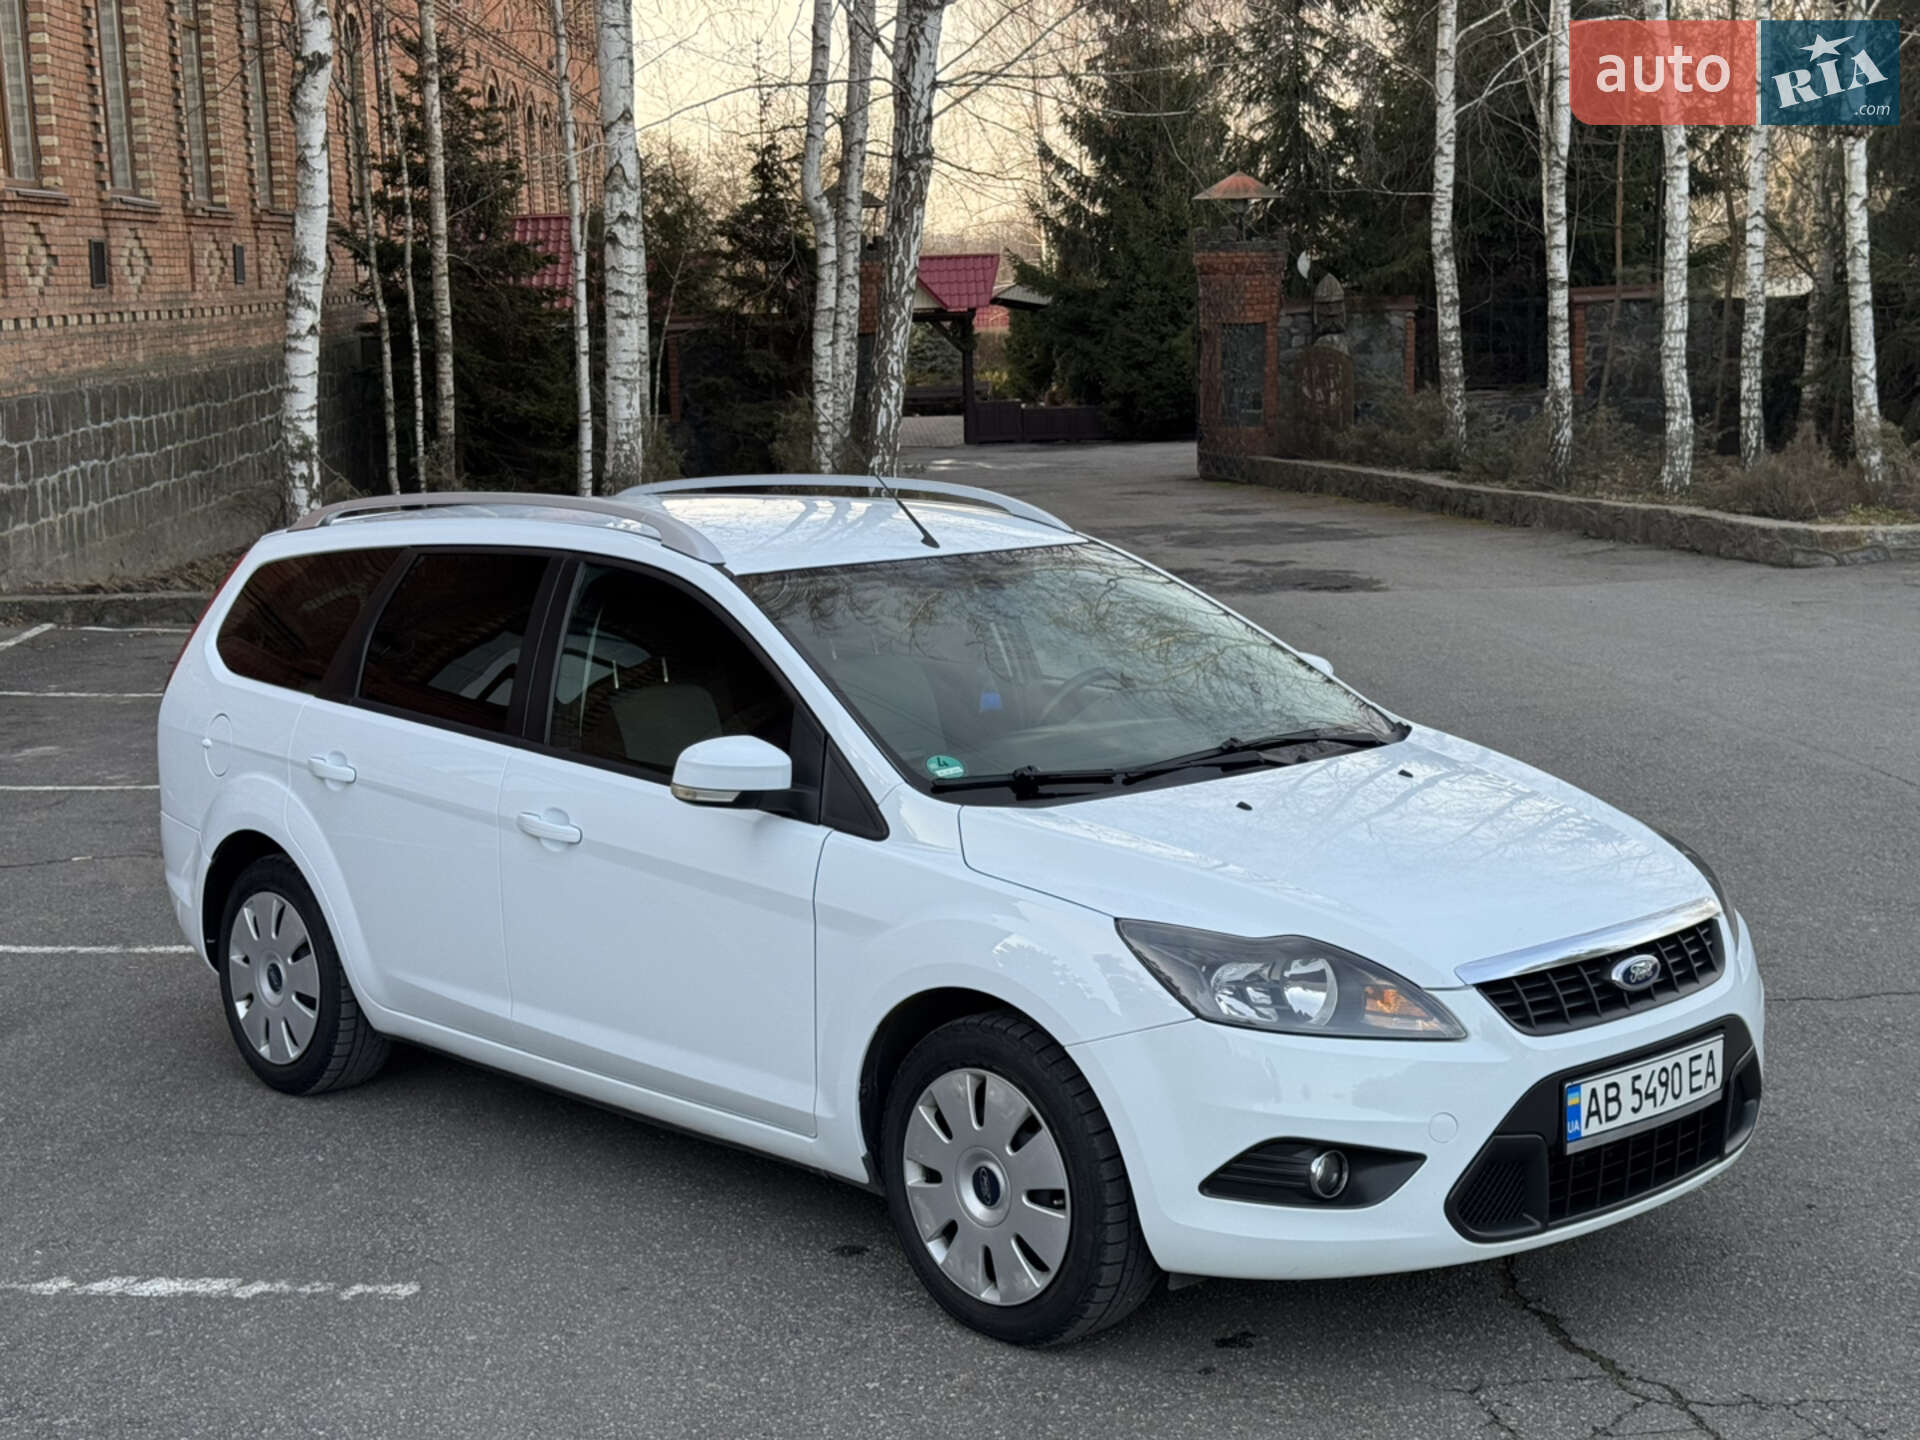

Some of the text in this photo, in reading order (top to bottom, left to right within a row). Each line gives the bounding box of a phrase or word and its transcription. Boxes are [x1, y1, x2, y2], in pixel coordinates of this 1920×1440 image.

[1584, 1049, 1717, 1129] AB 5490 EA
[1567, 1119, 1581, 1134] UA
